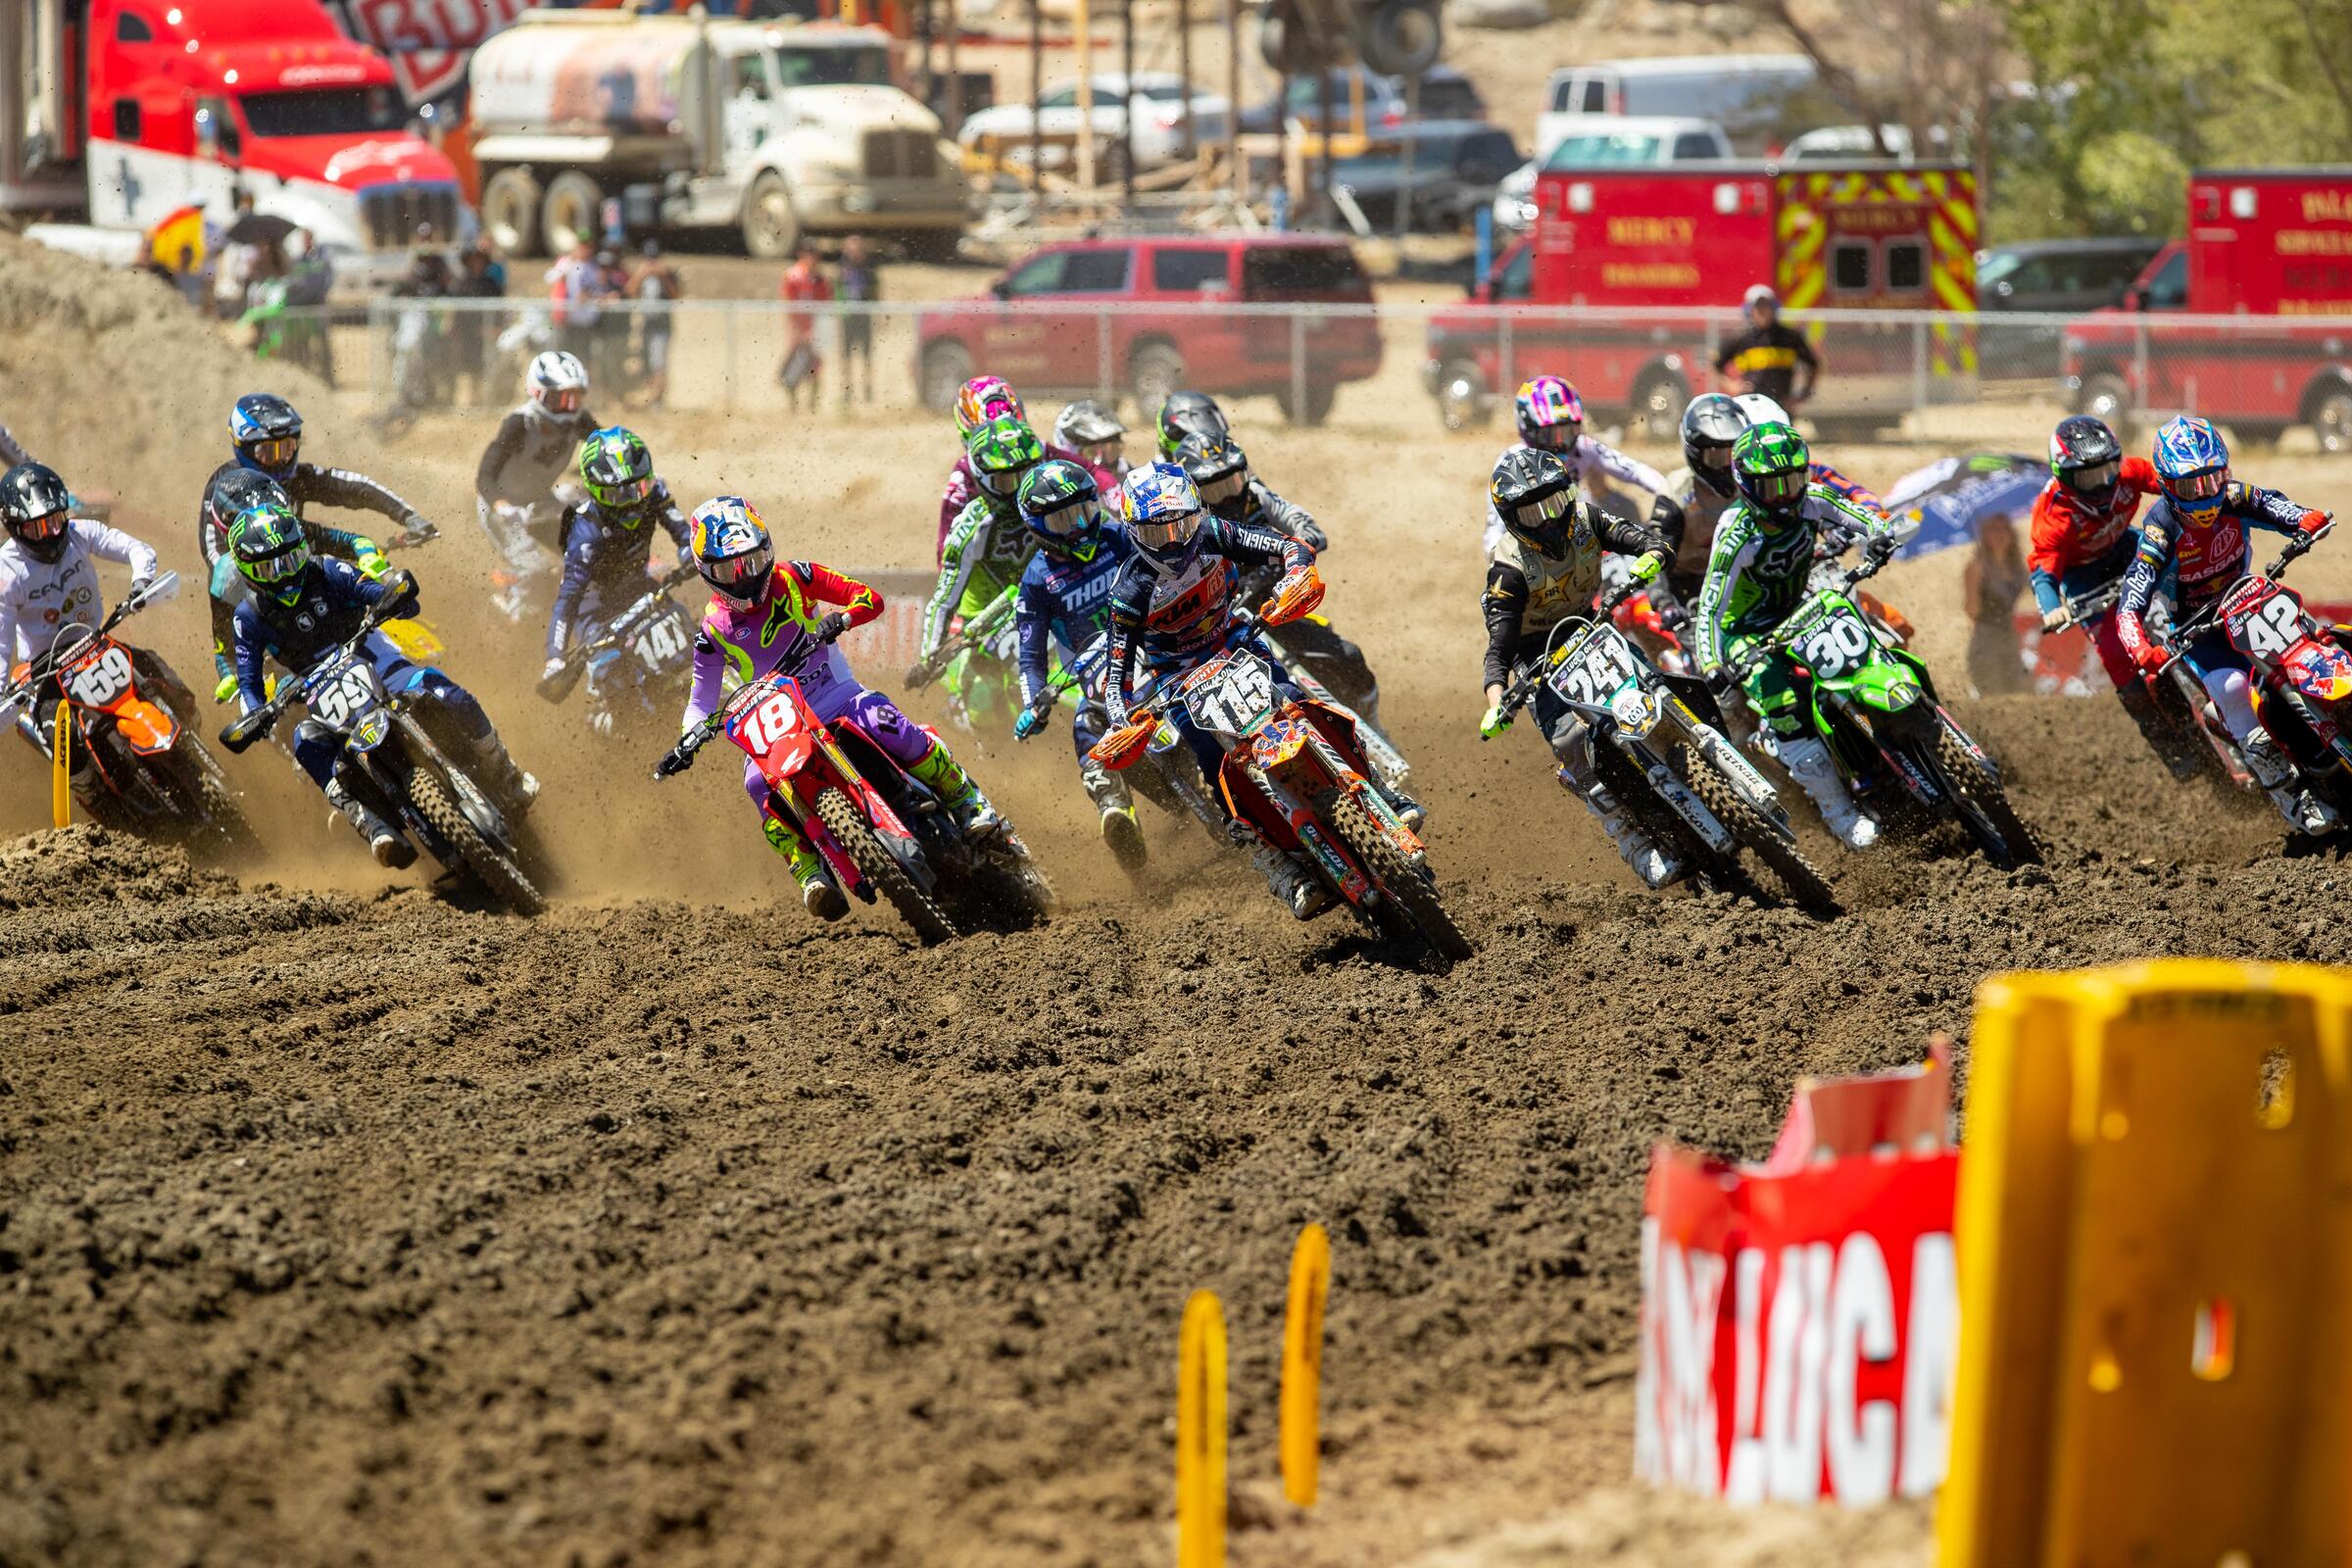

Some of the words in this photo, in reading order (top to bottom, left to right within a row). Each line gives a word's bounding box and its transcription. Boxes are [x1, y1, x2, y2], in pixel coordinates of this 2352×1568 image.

[2179, 543, 2245, 582] GASGAS
[1154, 593, 1202, 626] KTM
[1803, 619, 1827, 644] LUCAS
[2229, 619, 2245, 633] LUCAS
[2242, 612, 2253, 621] OIL
[2245, 593, 2305, 660] 42
[1567, 635, 1634, 707] 241
[1583, 643, 1595, 655] OIL
[1806, 614, 1869, 680] 30
[70, 647, 132, 708] 159
[318, 663, 373, 727] 59
[1200, 661, 1276, 736] 115
[739, 697, 759, 717] LUCAS
[745, 692, 799, 756] 18
[875, 706, 899, 734] 18
